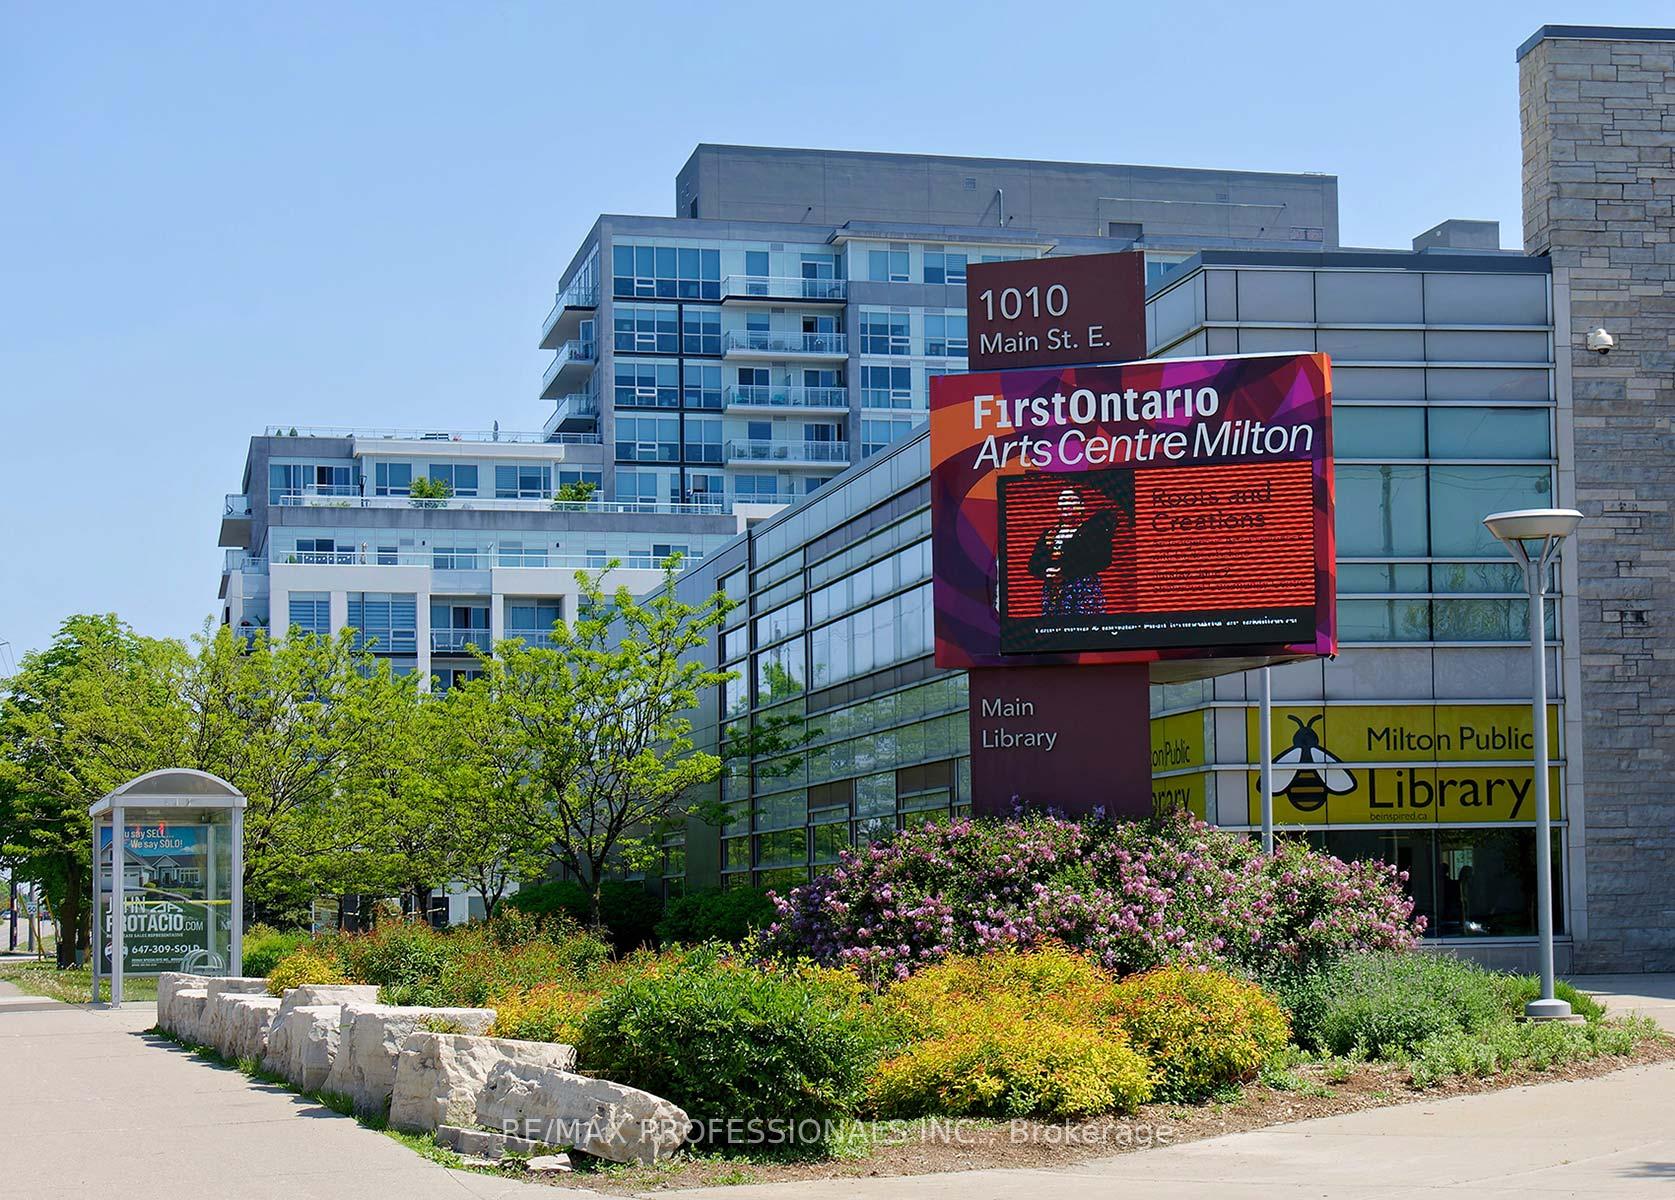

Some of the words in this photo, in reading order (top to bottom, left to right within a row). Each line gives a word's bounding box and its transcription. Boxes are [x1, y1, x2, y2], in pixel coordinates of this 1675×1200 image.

[979, 284, 1069, 320] 1010
[979, 331, 1039, 355] Main
[1047, 327, 1078, 350] St.
[1088, 325, 1112, 348] E.
[973, 386, 1220, 430] FirstOntario
[973, 437, 1053, 471] Arts
[1057, 426, 1188, 464] Centre
[1192, 419, 1314, 457] Milton
[1151, 486, 1219, 508] Roots
[1229, 479, 1271, 504] and
[1151, 511, 1266, 532] Creations
[981, 698, 1034, 717] Main
[982, 728, 1058, 751] Library
[1367, 727, 1450, 751] Milton
[1460, 726, 1534, 750] Public
[1368, 768, 1532, 819] Library
[1370, 812, 1428, 822] beinspired.ca
[130, 831, 146, 840] say
[130, 840, 143, 849] We
[143, 841, 159, 849] say
[106, 896, 146, 913] JHN
